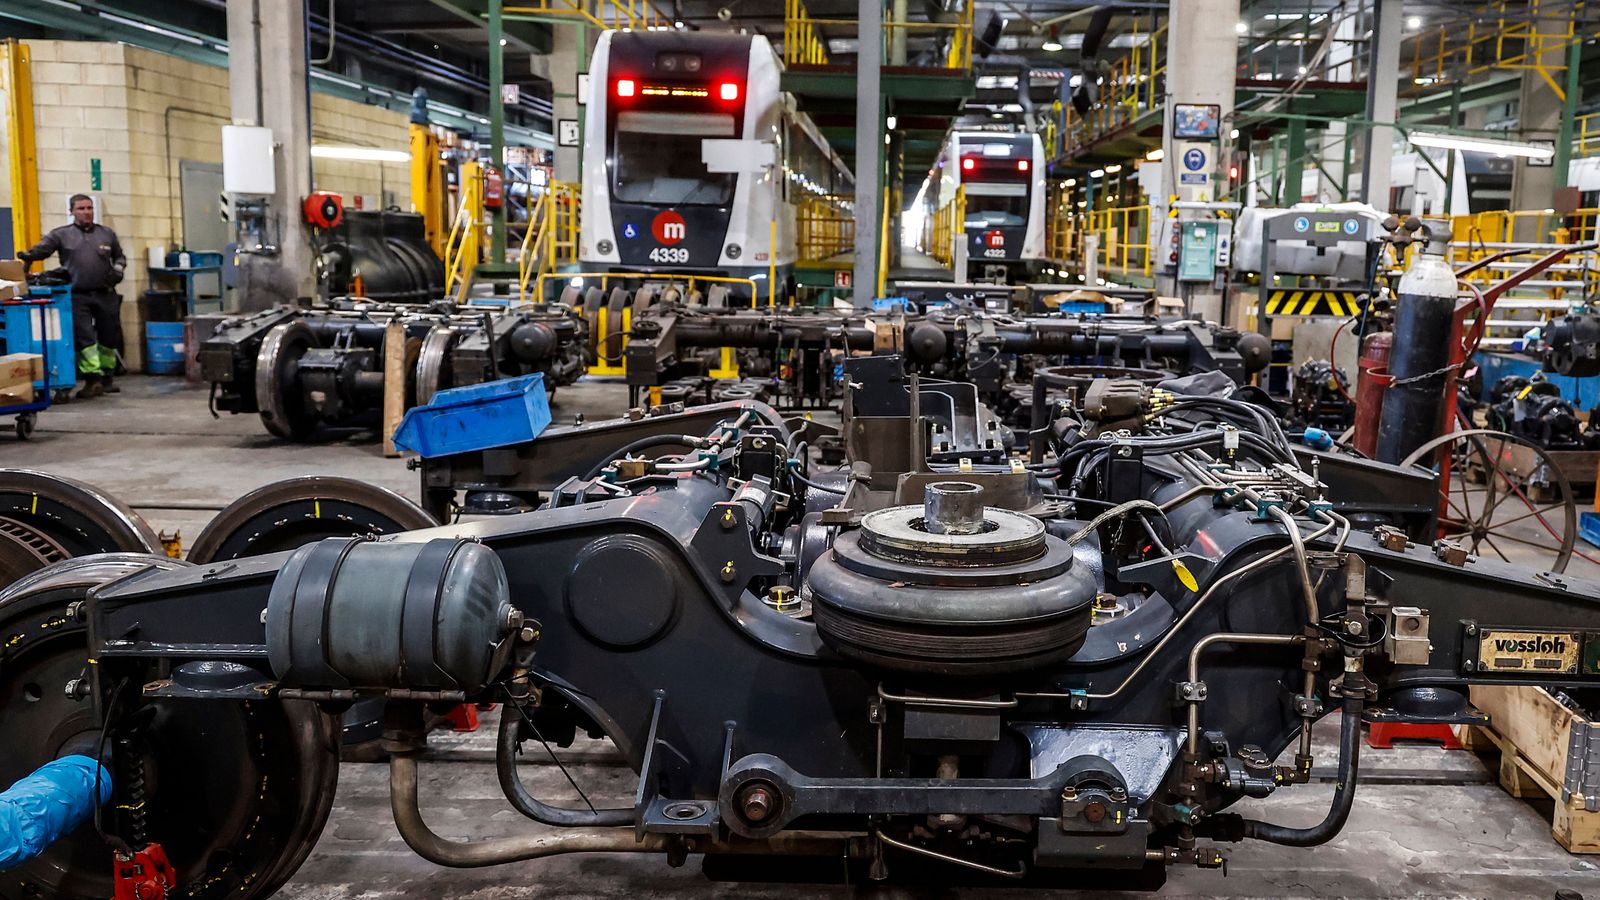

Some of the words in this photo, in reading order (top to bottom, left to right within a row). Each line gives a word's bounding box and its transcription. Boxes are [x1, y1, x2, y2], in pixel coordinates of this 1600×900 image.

[664, 223, 686, 239] m
[649, 247, 689, 263] 4339
[1495, 636, 1565, 654] vossloh
